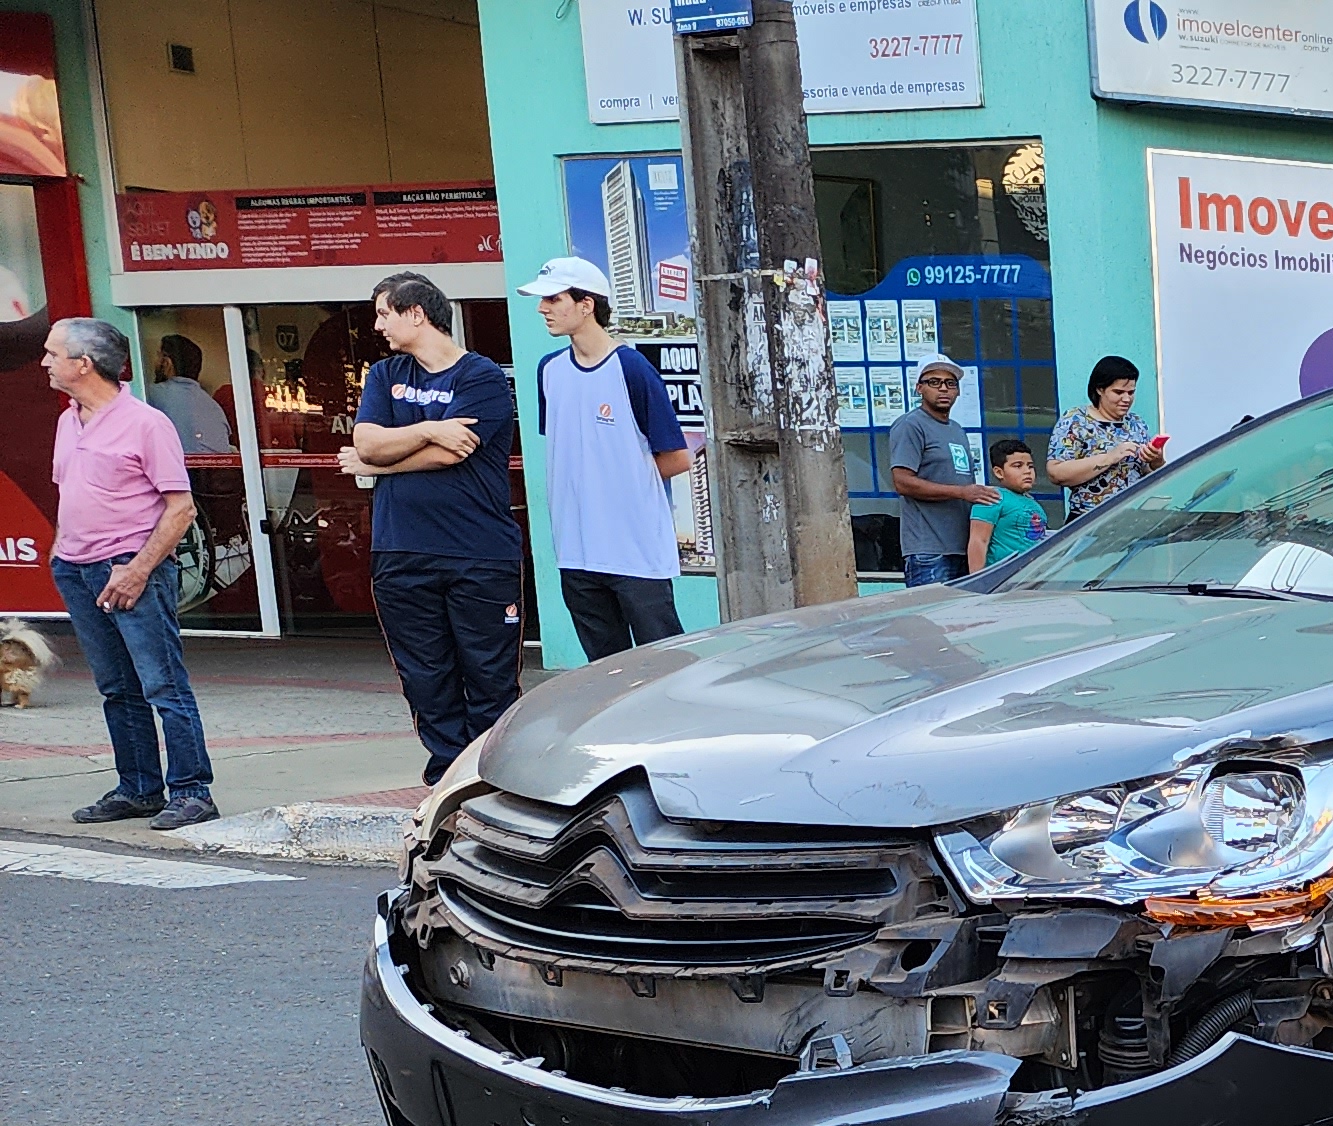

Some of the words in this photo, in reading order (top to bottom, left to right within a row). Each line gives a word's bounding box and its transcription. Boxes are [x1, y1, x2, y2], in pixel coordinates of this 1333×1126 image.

[627, 8, 647, 27] W.
[839, 3, 846, 13] e
[850, 0, 911, 14] empresas
[869, 33, 963, 59] 3227-7777
[599, 95, 641, 110] compra
[842, 86, 849, 97] e
[851, 82, 886, 97] venda
[890, 81, 904, 95] de
[908, 80, 966, 97] empresas
[130, 241, 142, 261] É
[143, 241, 229, 261] BEM-VINDO
[1178, 242, 1268, 271] Negócios
[924, 264, 1022, 285] 99125-7777
[660, 346, 697, 371] AQUI
